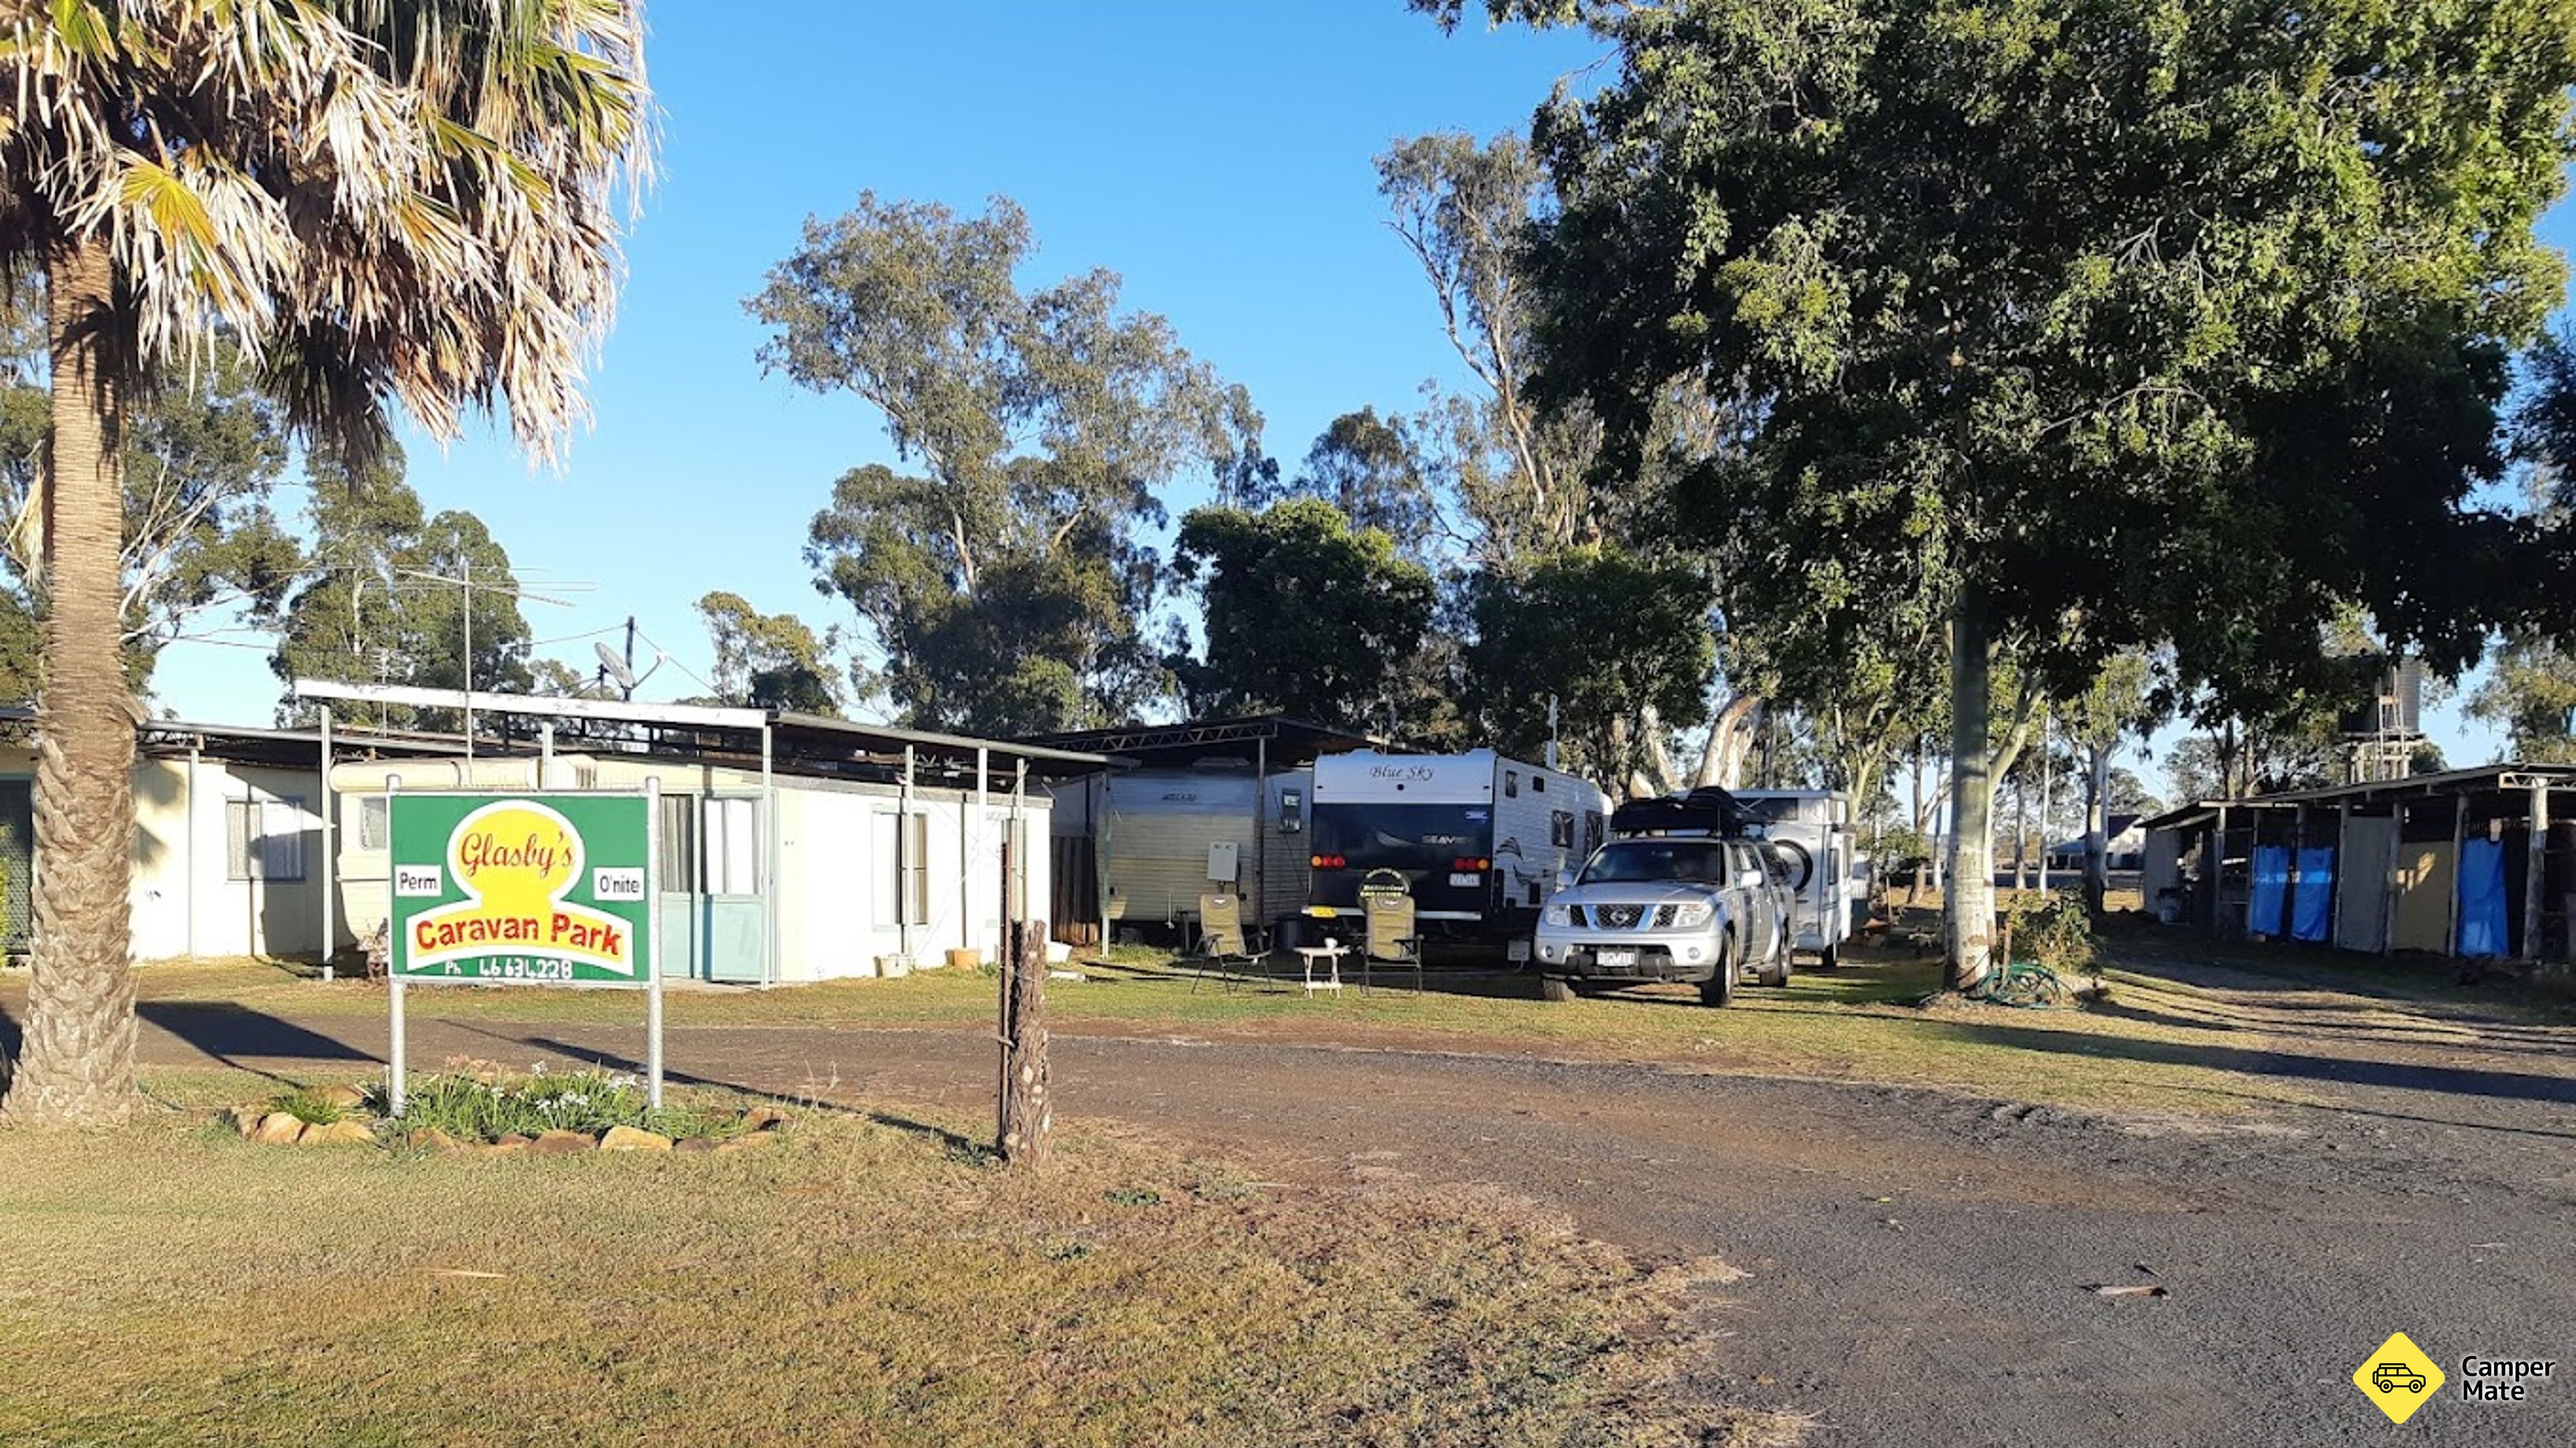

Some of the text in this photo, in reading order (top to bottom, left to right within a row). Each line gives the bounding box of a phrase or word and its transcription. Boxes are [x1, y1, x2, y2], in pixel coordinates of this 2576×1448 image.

[1369, 765, 1434, 781] Blue Sky
[461, 832, 573, 878] Glasby's
[400, 874, 437, 890] Perm
[600, 876, 639, 893] O'nite
[416, 913, 622, 955] Caravan Park
[444, 961, 462, 975] Ph
